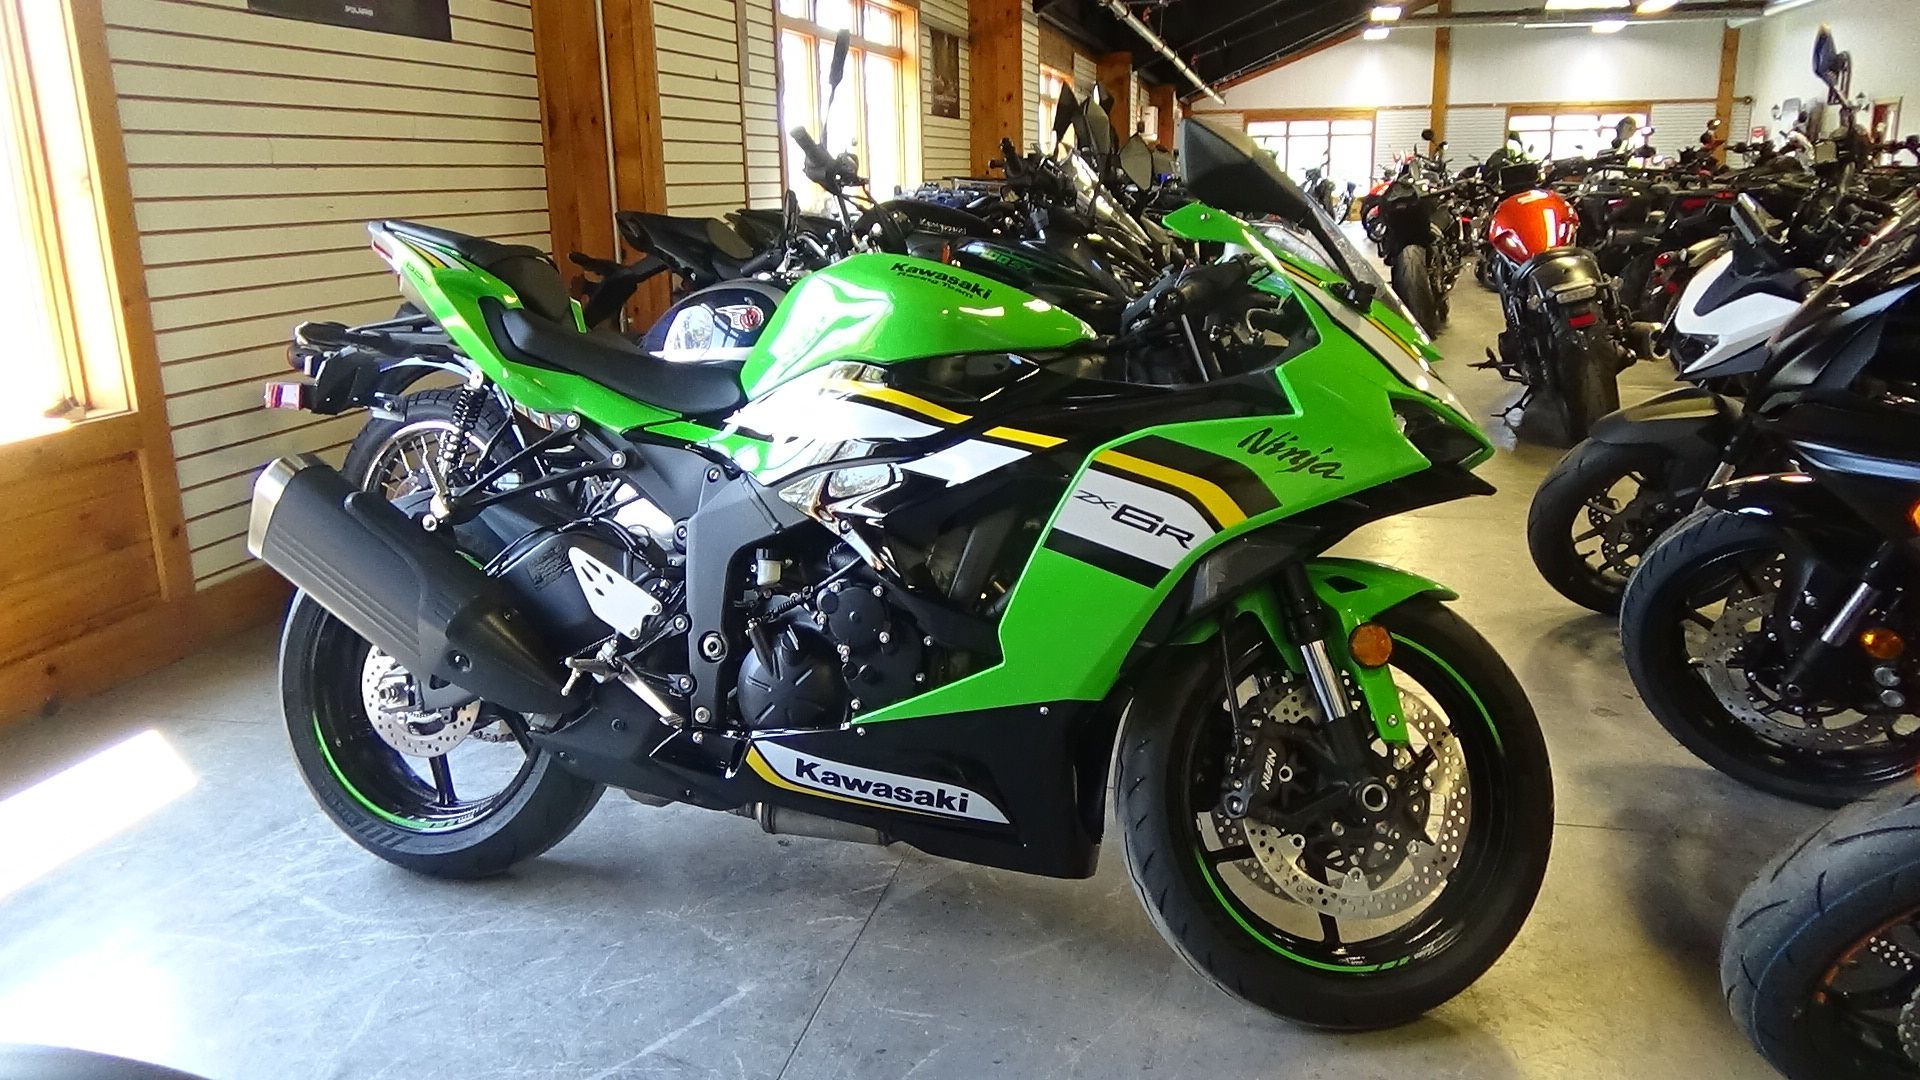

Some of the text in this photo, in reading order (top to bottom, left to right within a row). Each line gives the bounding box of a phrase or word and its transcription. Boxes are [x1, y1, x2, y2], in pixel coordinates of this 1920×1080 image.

[890, 262, 993, 300] Kawasaki
[1236, 427, 1345, 480] Ninja
[795, 757, 969, 813] Kawasaki
